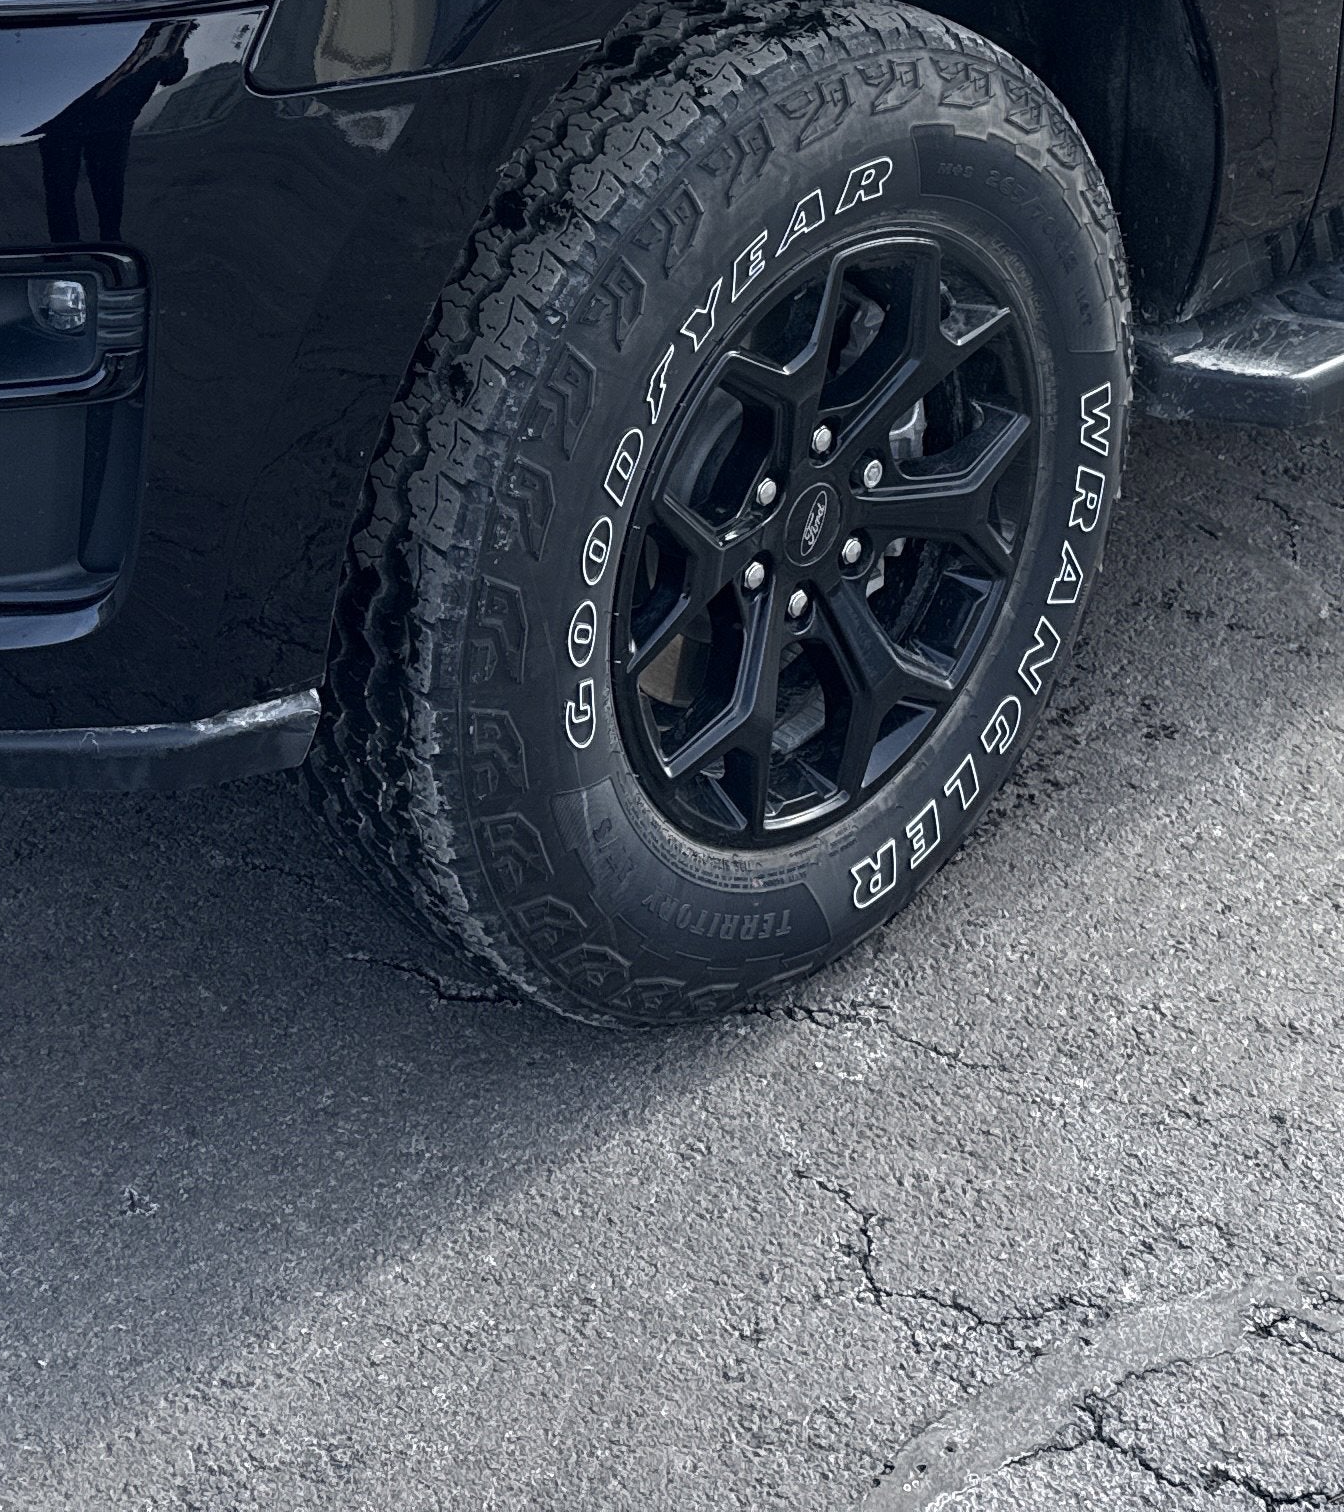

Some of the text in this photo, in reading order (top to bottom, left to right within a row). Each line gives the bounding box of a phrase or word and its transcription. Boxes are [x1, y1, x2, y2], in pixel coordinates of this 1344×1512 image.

[564, 156, 894, 748] GOODYEAR
[804, 501, 826, 546] Ford
[851, 381, 1113, 909] WRANGLER
[641, 893, 792, 940] TERRITORY
